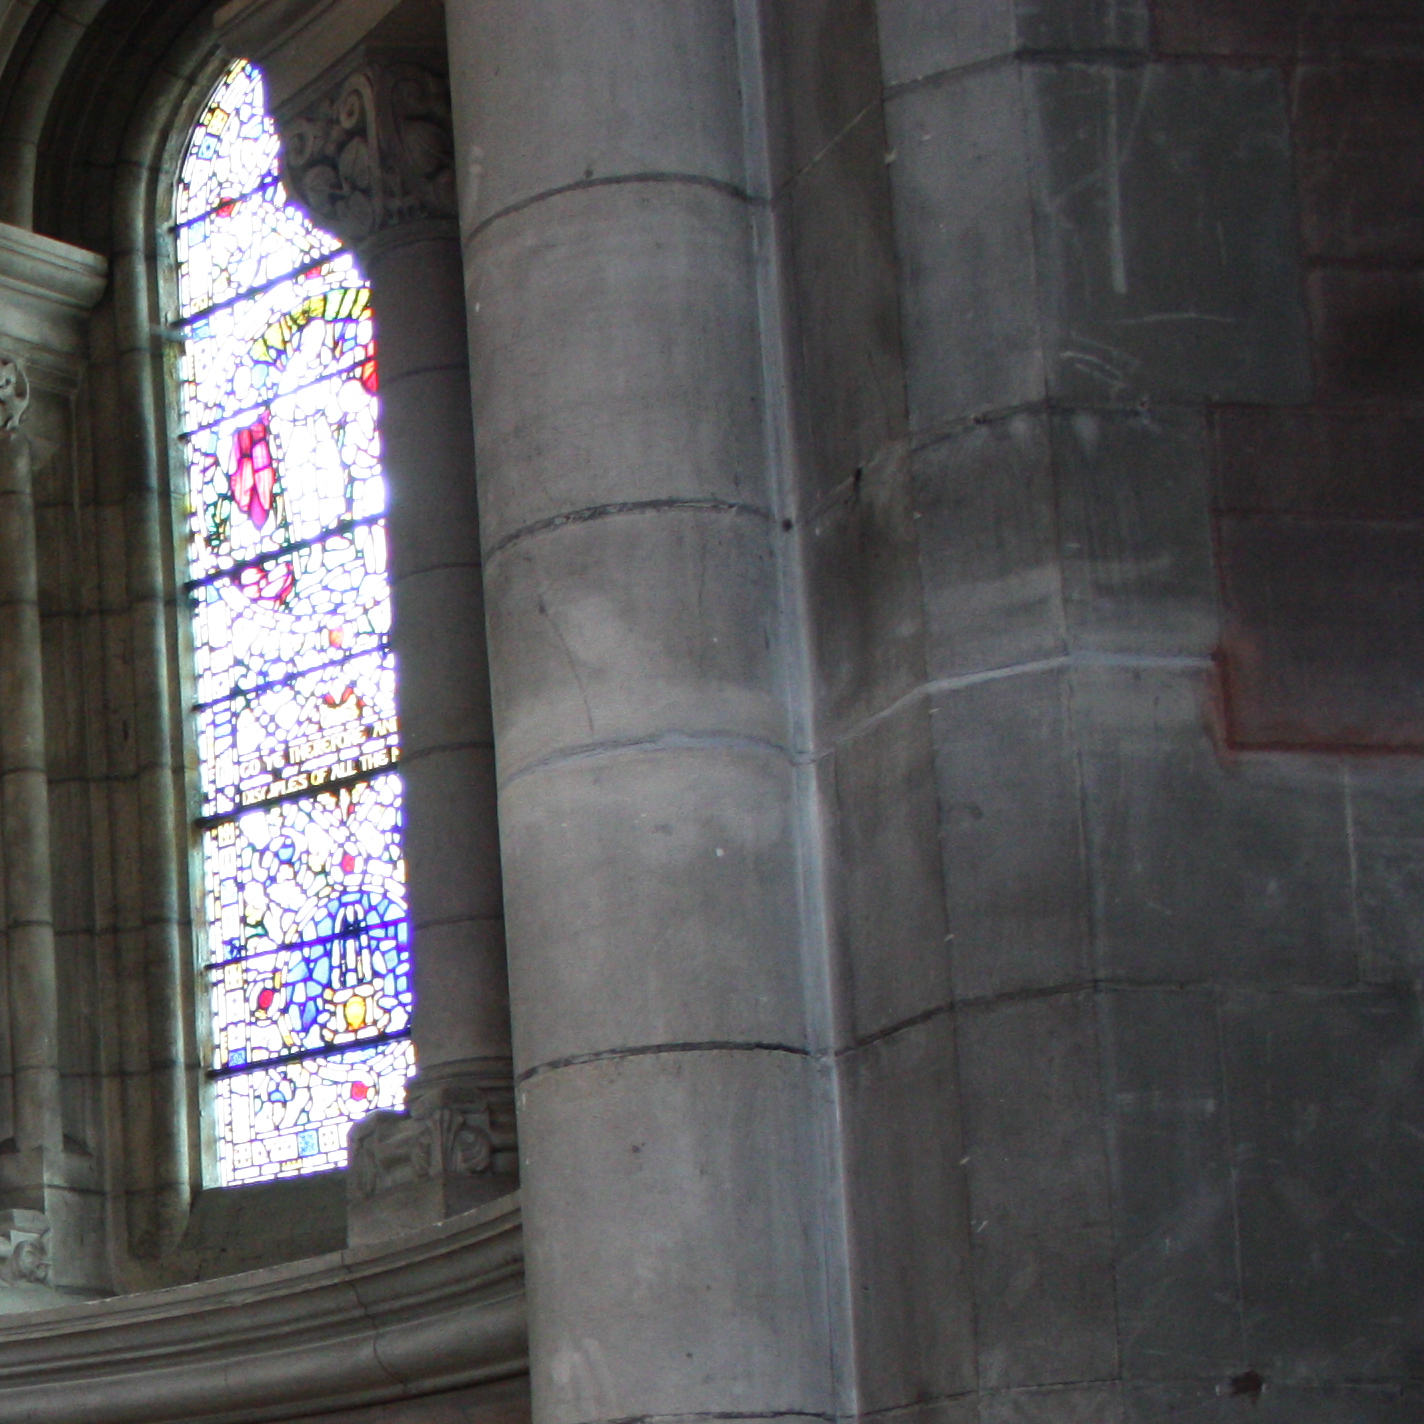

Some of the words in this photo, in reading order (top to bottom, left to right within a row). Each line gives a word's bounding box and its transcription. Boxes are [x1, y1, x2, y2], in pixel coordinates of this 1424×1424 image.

[239, 758, 261, 779] GO
[263, 750, 285, 771] YE
[289, 726, 366, 764] THEREFORE
[372, 716, 399, 738] AN
[242, 773, 308, 806] DISCIPLES
[311, 767, 328, 786] OF
[330, 760, 357, 781] ALL
[359, 749, 388, 771] THE
